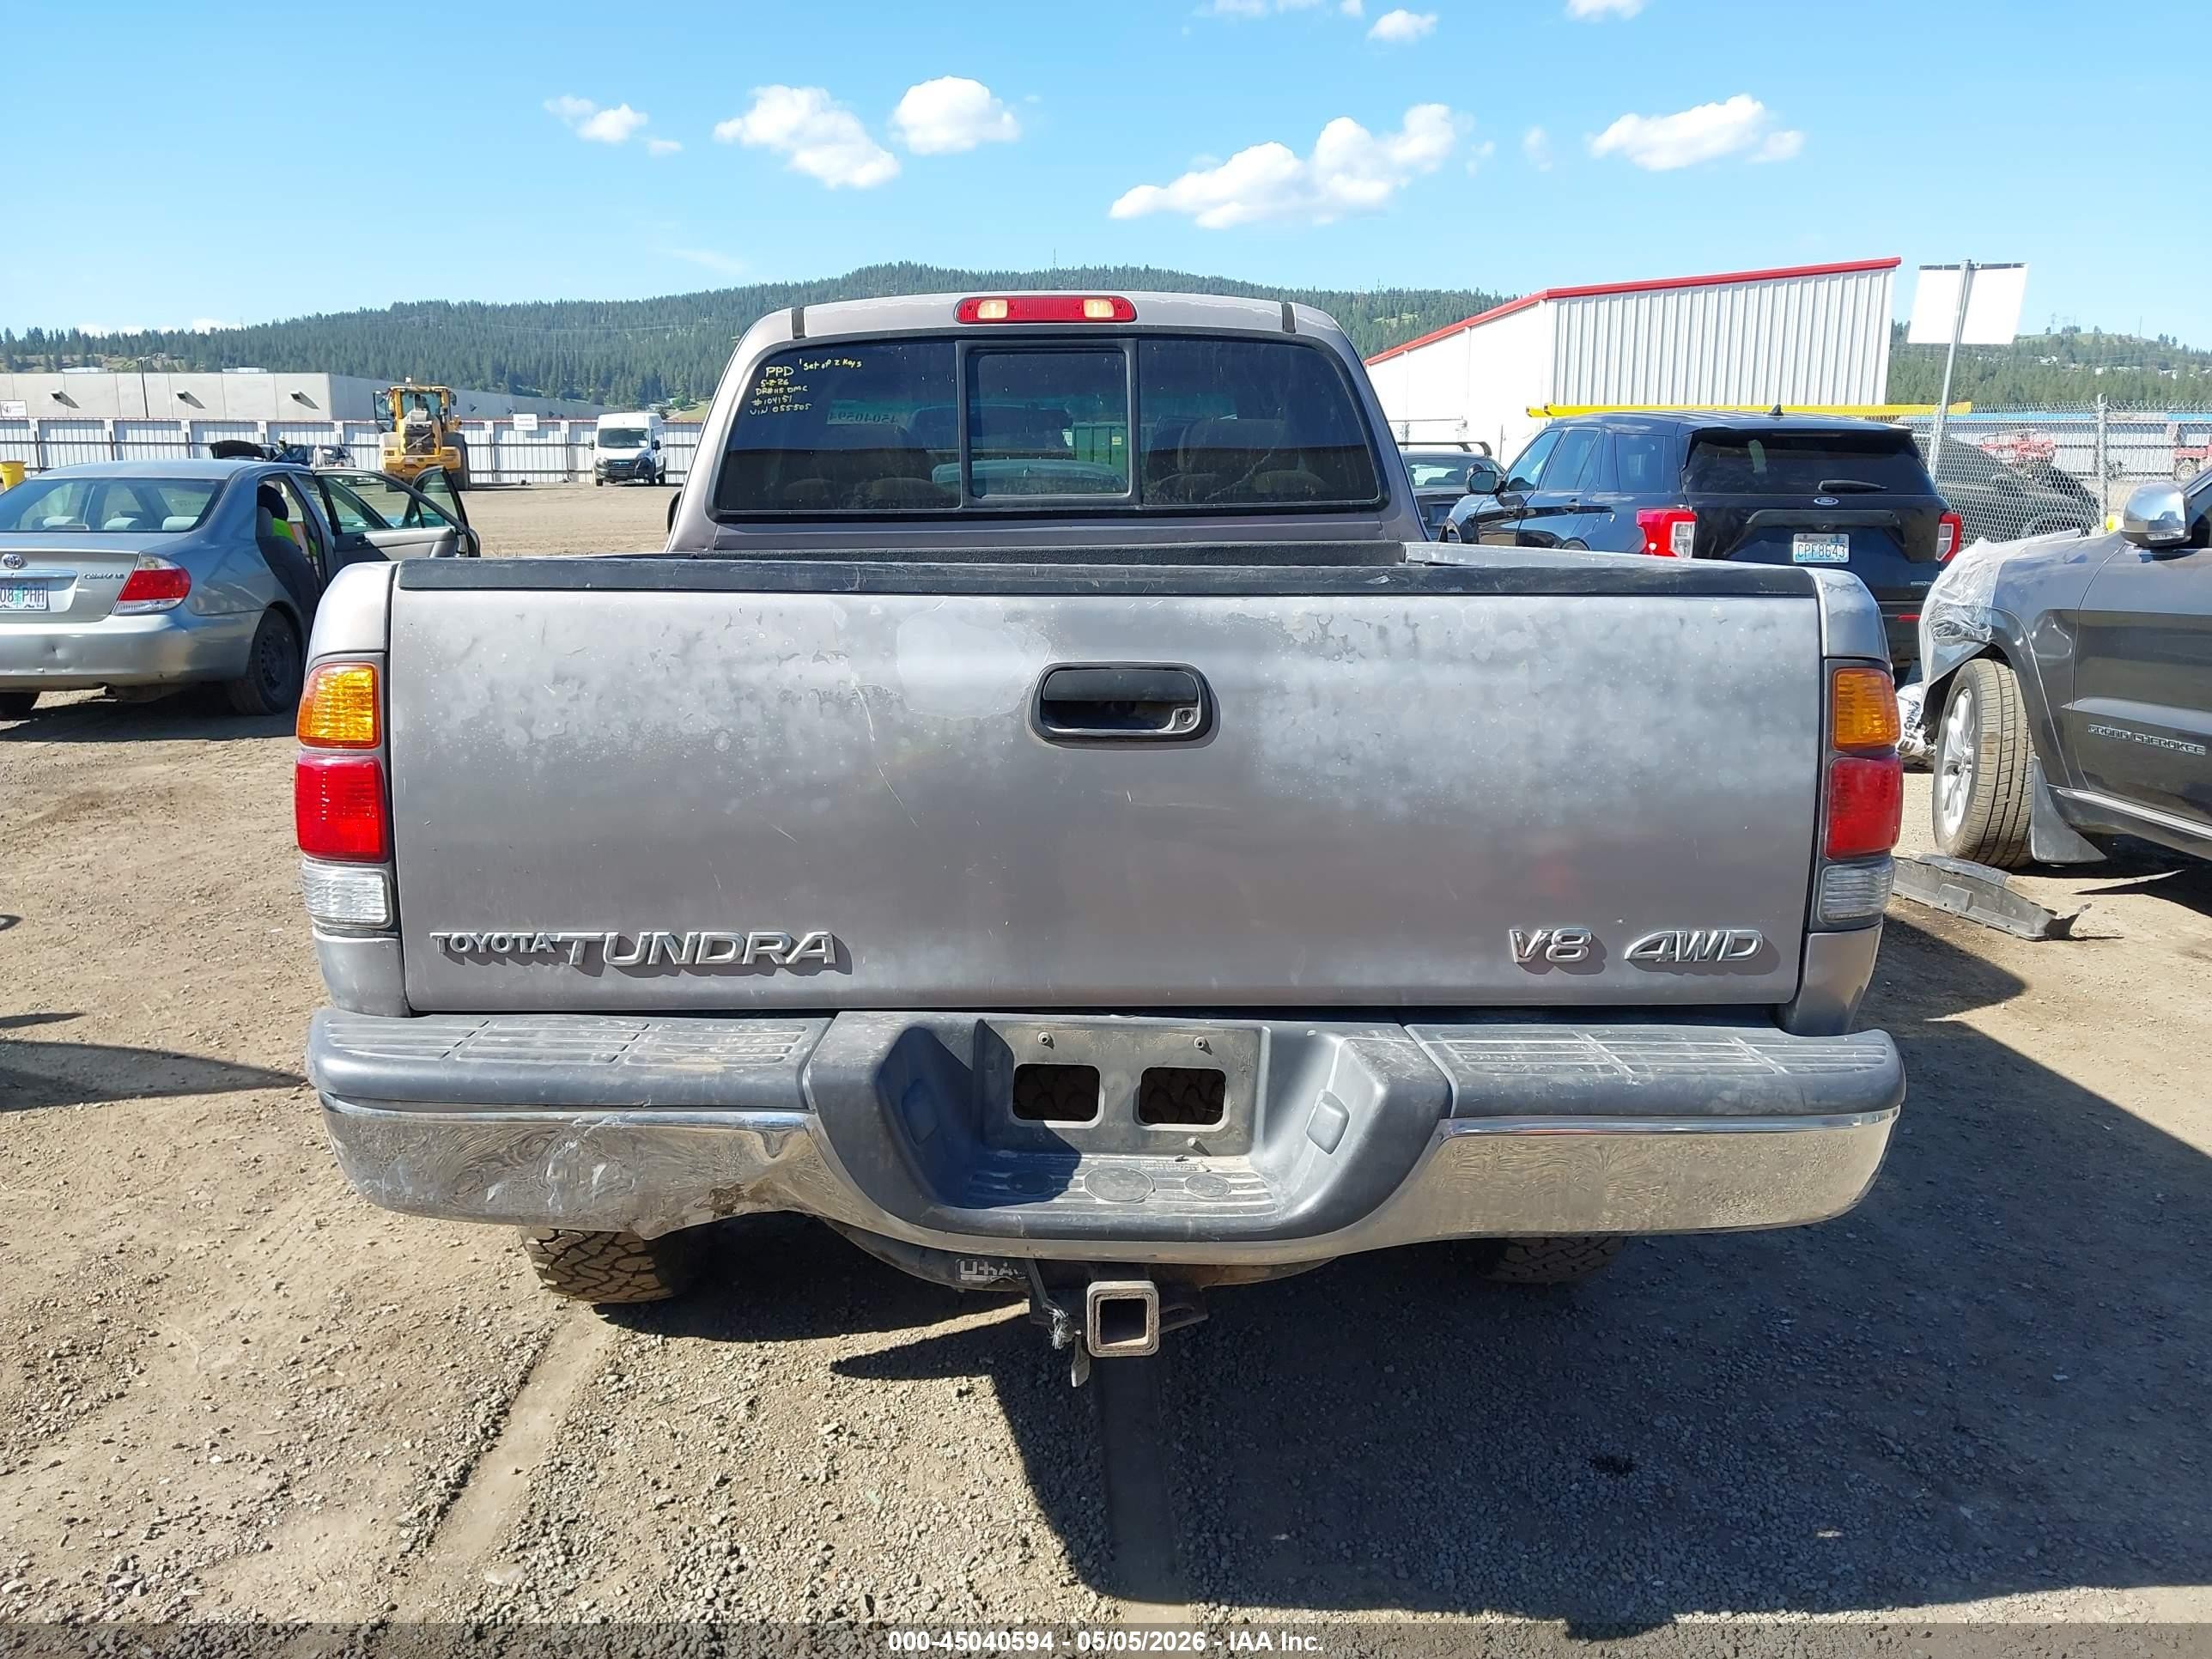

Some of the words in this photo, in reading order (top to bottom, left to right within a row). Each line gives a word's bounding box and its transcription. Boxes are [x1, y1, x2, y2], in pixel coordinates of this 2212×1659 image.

[765, 366, 794, 378] PPD
[803, 361, 820, 371] Set
[821, 359, 832, 369] of
[749, 405, 769, 416] VIN
[772, 403, 813, 413] 055505
[1797, 544, 1845, 558] CPF8643
[2087, 724, 2132, 740] GRAND
[2132, 732, 2206, 756] CHEROKEE
[429, 932, 558, 954] TOYOTA
[551, 932, 836, 966] TUNDRA
[1509, 927, 1591, 963] V8
[1624, 929, 1763, 963] 4WD
